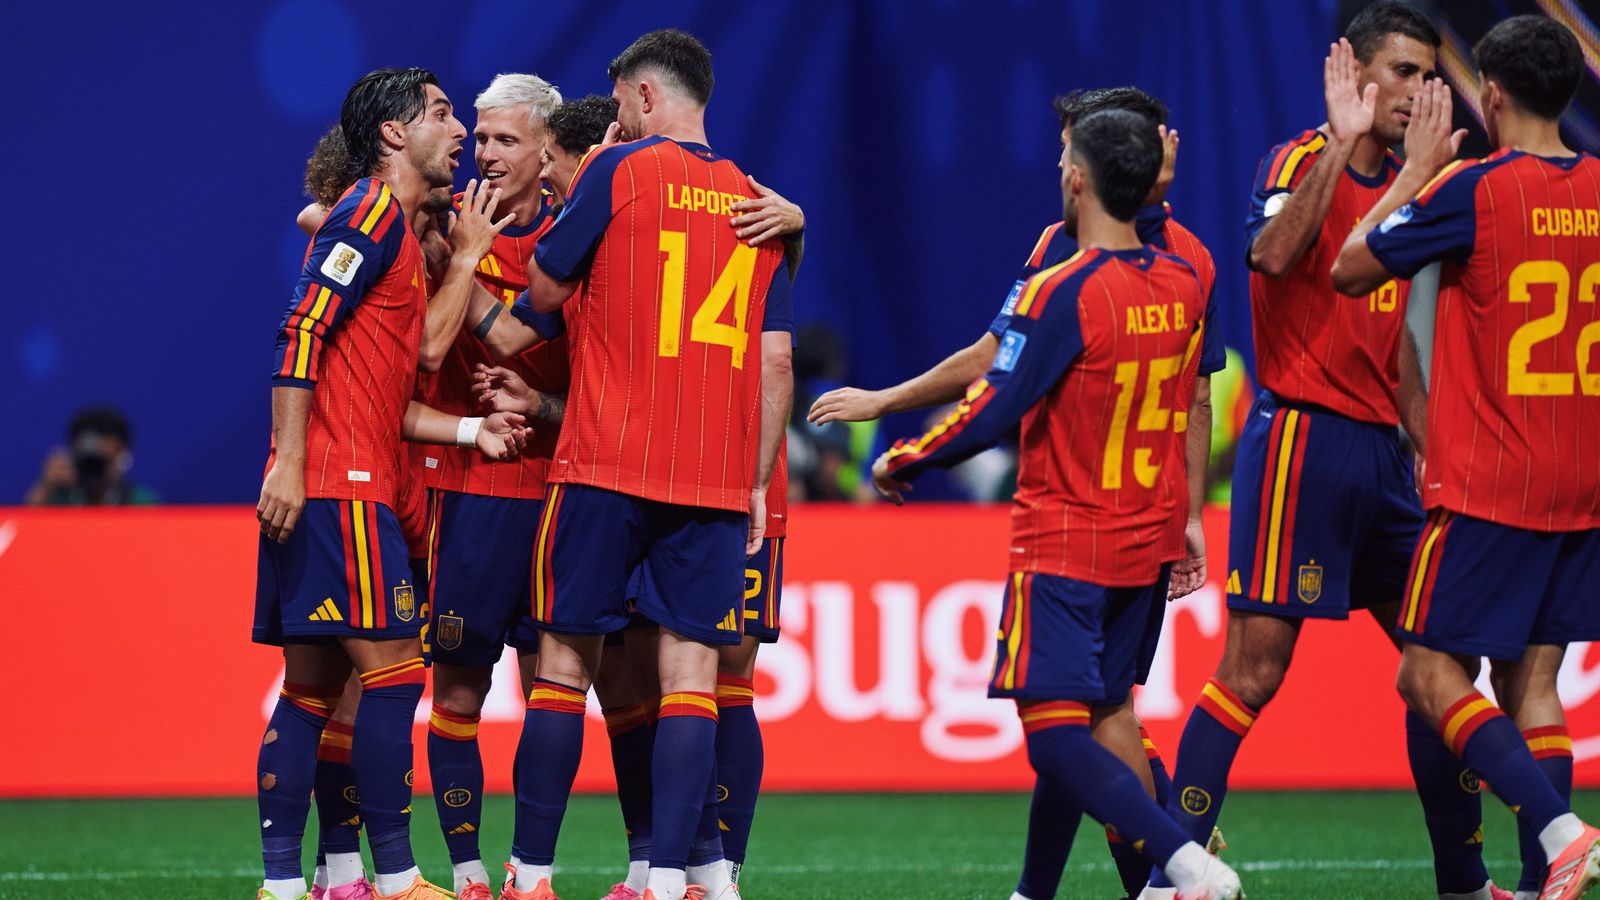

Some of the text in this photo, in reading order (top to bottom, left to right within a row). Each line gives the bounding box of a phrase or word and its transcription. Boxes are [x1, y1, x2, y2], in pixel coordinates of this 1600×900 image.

[667, 183, 749, 217] LAPORT
[1532, 207, 1600, 237] CUBAR
[658, 229, 759, 371] 14
[1126, 302, 1187, 335] ALEX B.
[1101, 353, 1184, 490] 15
[752, 579, 1222, 763] sugr
